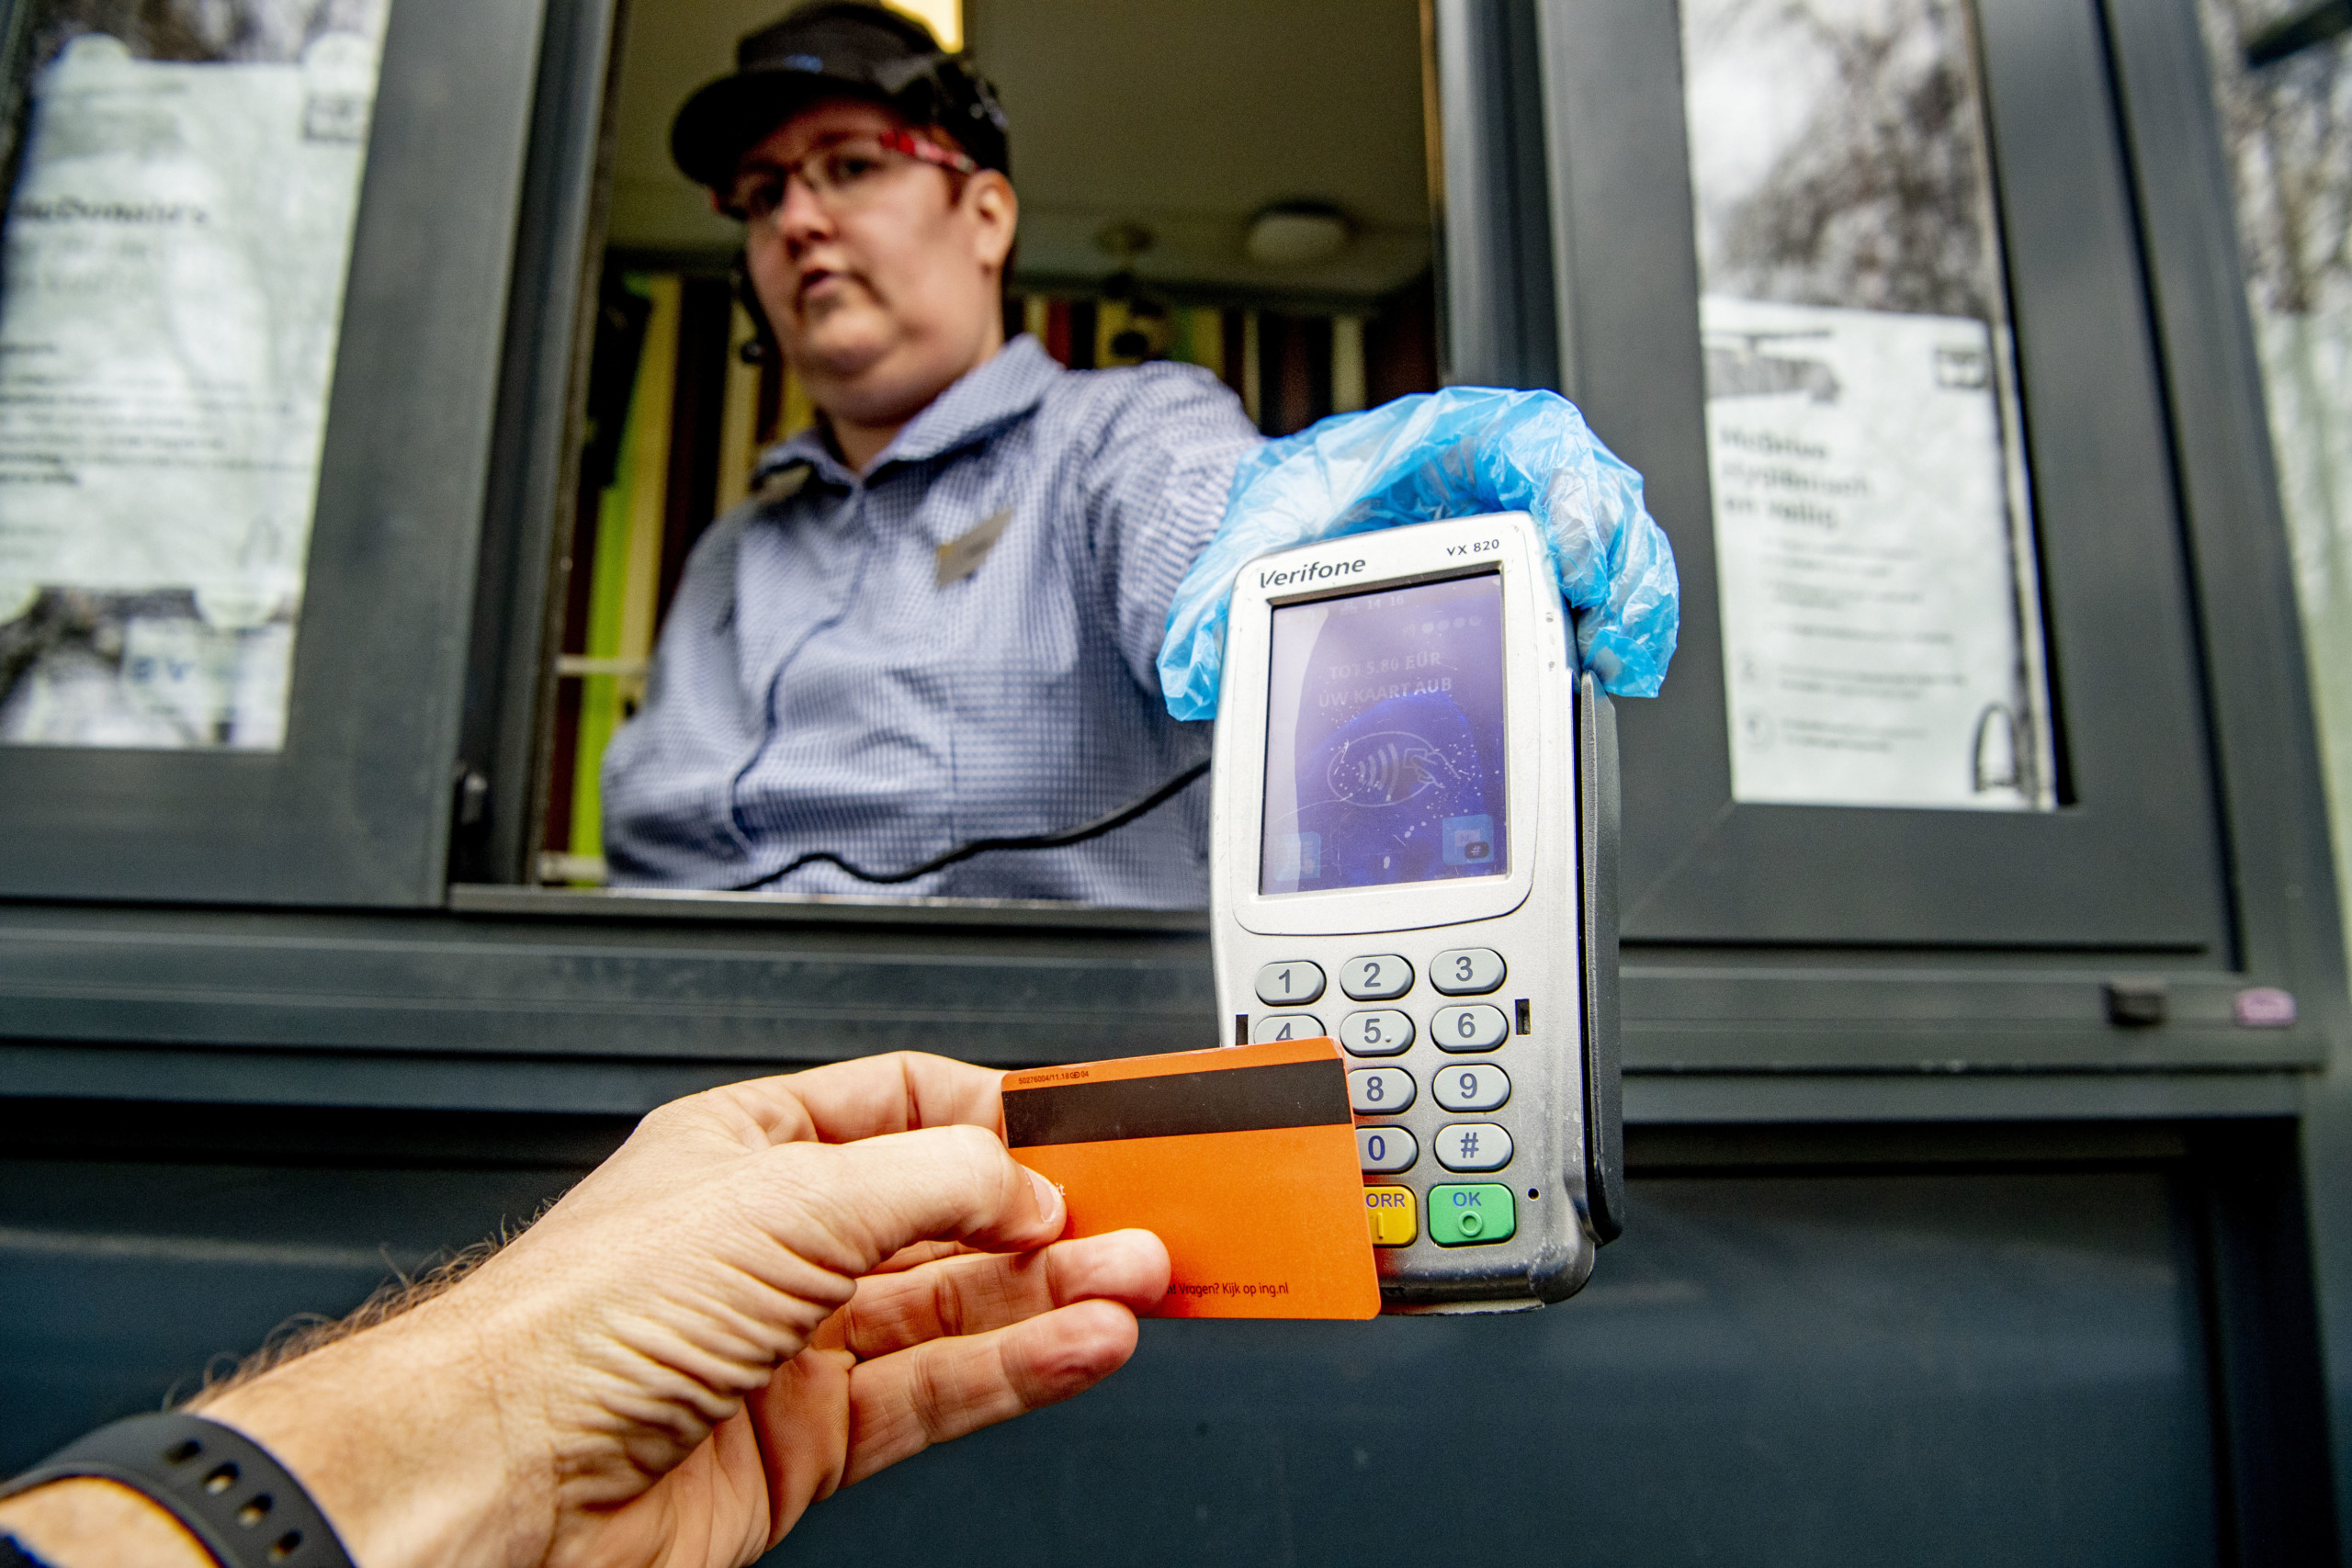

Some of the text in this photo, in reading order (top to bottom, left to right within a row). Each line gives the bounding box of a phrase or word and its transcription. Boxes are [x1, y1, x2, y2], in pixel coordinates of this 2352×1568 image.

[1447, 538, 1499, 557] VX 820
[1260, 558, 1366, 589] Verifone
[1406, 651, 1442, 671] EUR
[1318, 677, 1453, 708] UW KAART AUB
[1278, 968, 1291, 994] 1
[1363, 962, 1381, 987] 2
[1455, 956, 1474, 982] 3
[1275, 1022, 1294, 1042] 4
[1363, 1018, 1381, 1043] 5
[1457, 1012, 1476, 1039] 6
[1366, 1076, 1385, 1101] 8
[1459, 1073, 1477, 1100] 9
[1367, 1135, 1385, 1161] 0
[1460, 1132, 1479, 1159] #
[1365, 1193, 1406, 1209] ORR
[1453, 1191, 1482, 1208] OK
[1178, 1283, 1219, 1297] Vragen?
[1223, 1282, 1240, 1297] Kijk
[1243, 1284, 1257, 1297] op
[1259, 1282, 1289, 1297] ing.nl
